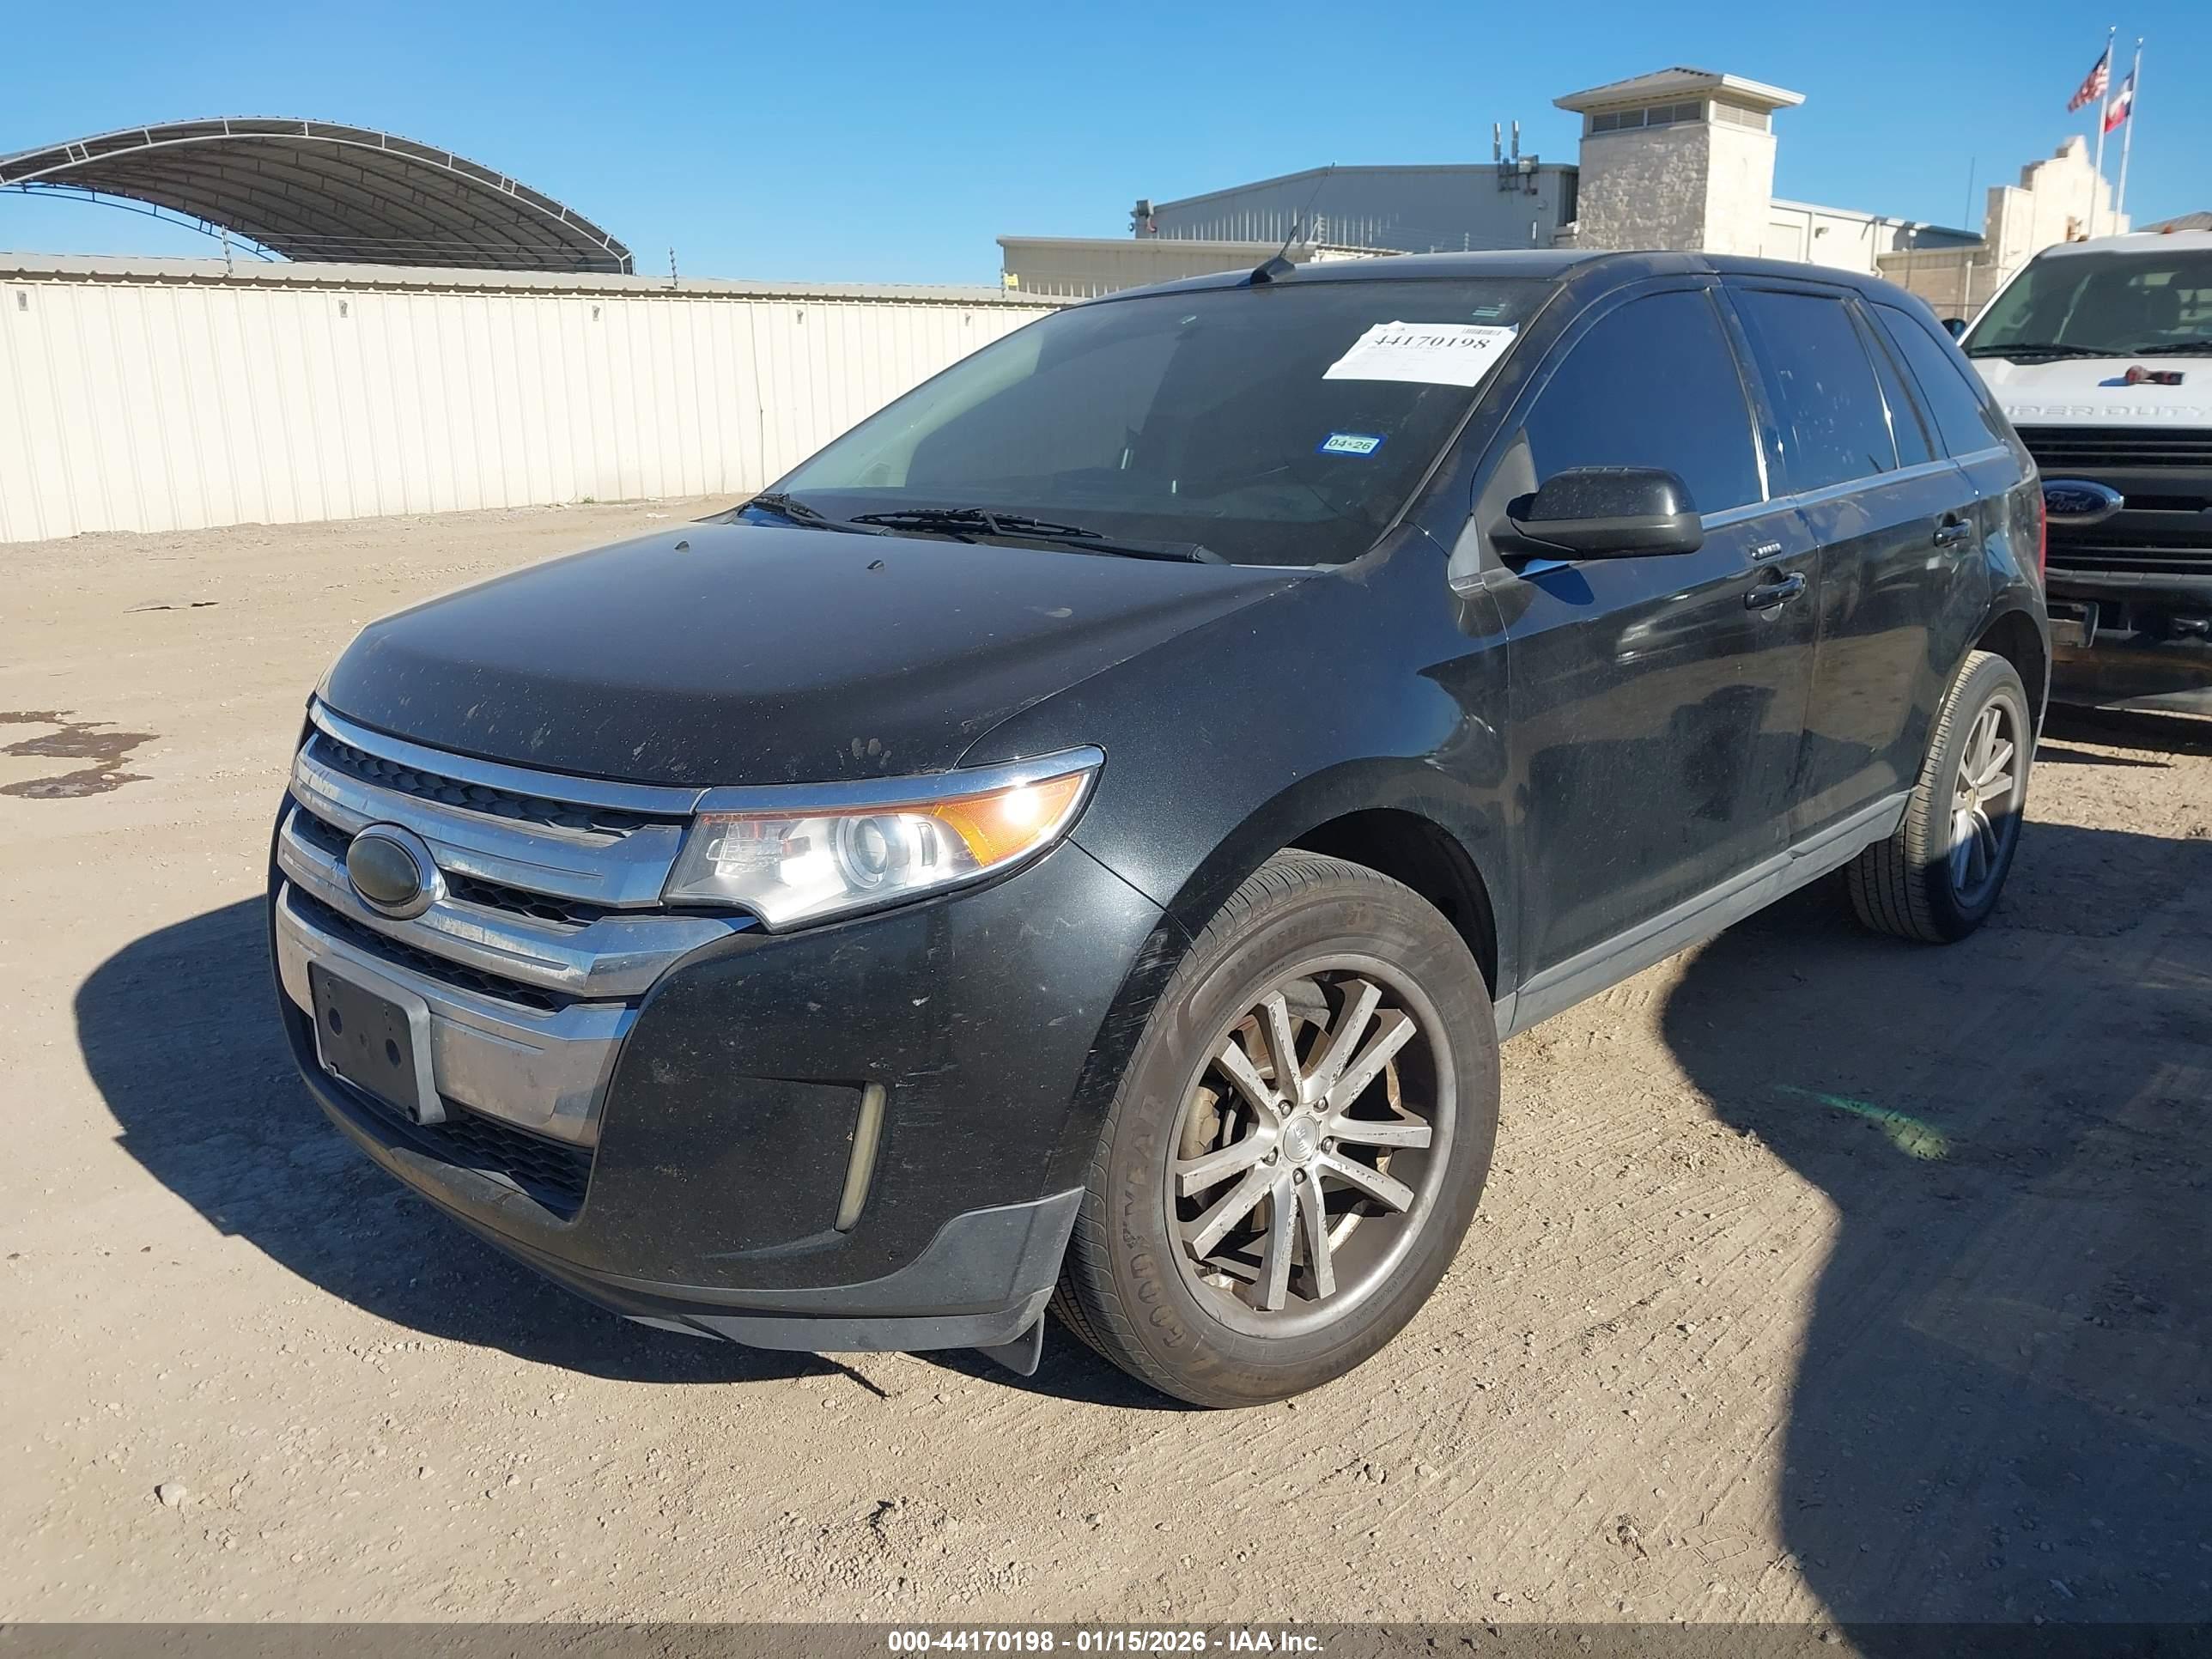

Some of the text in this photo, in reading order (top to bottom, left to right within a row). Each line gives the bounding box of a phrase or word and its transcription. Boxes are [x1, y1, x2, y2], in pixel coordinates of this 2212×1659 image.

[1375, 334, 1491, 350] 44170198
[2103, 405, 2212, 417] DUTY
[2046, 490, 2090, 513] Ford
